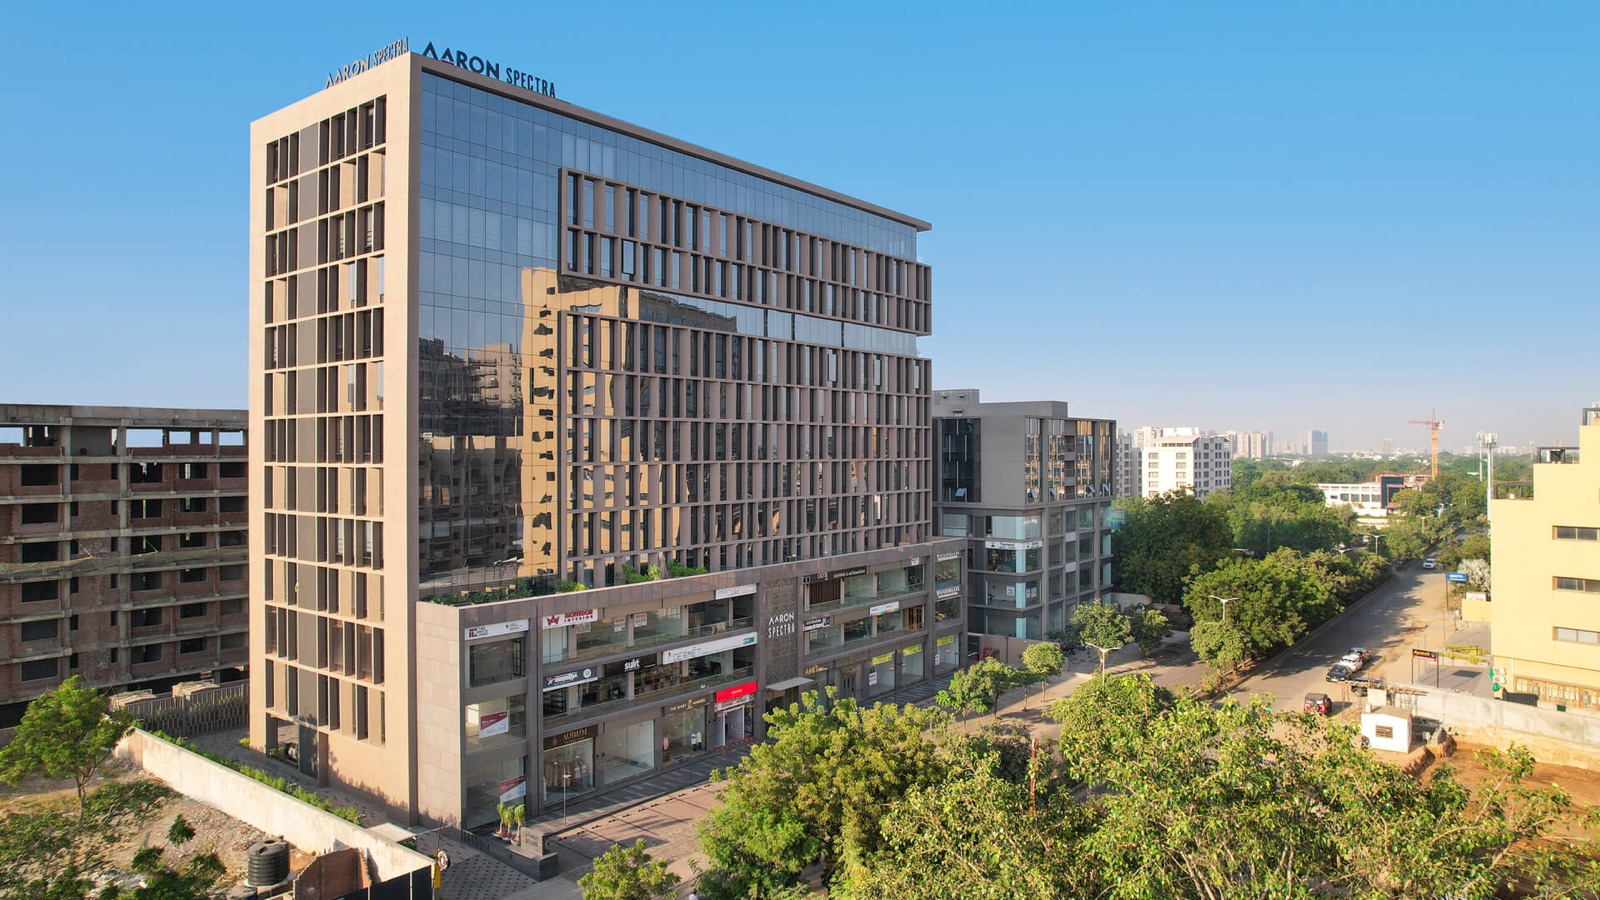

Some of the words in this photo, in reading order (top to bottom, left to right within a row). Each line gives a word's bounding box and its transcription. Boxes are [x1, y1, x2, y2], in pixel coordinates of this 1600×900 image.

[325, 52, 370, 90] AARON
[373, 35, 409, 67] SPECTRA
[422, 41, 500, 80] AARON
[506, 67, 556, 98] SPECTRA
[564, 614, 593, 623] INTERIOR
[768, 612, 795, 626] AARON
[768, 622, 795, 639] SPECTRA
